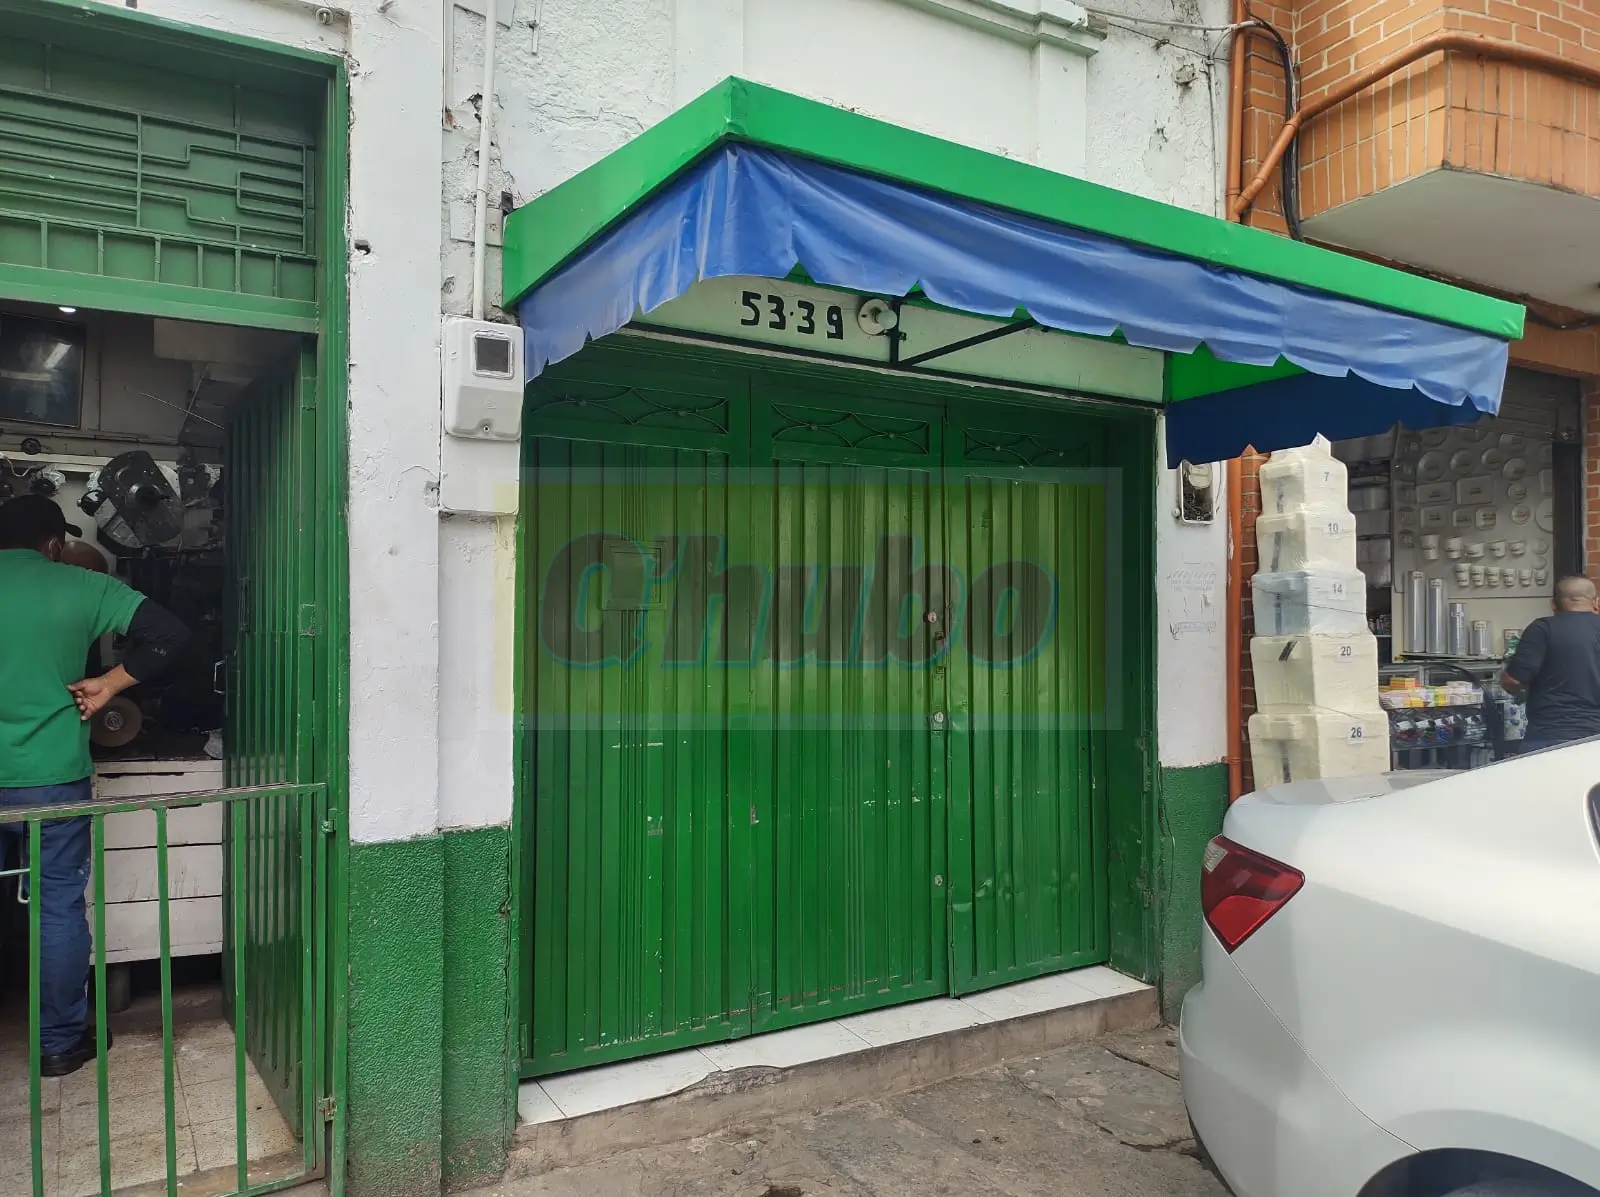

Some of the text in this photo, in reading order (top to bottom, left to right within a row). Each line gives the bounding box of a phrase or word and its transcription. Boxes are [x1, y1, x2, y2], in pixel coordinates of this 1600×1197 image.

[1323, 471, 1330, 482] 7
[1327, 522, 1339, 534] 10
[1332, 583, 1343, 594] 14
[1340, 646, 1352, 656] 20
[1350, 727, 1363, 739] 26
